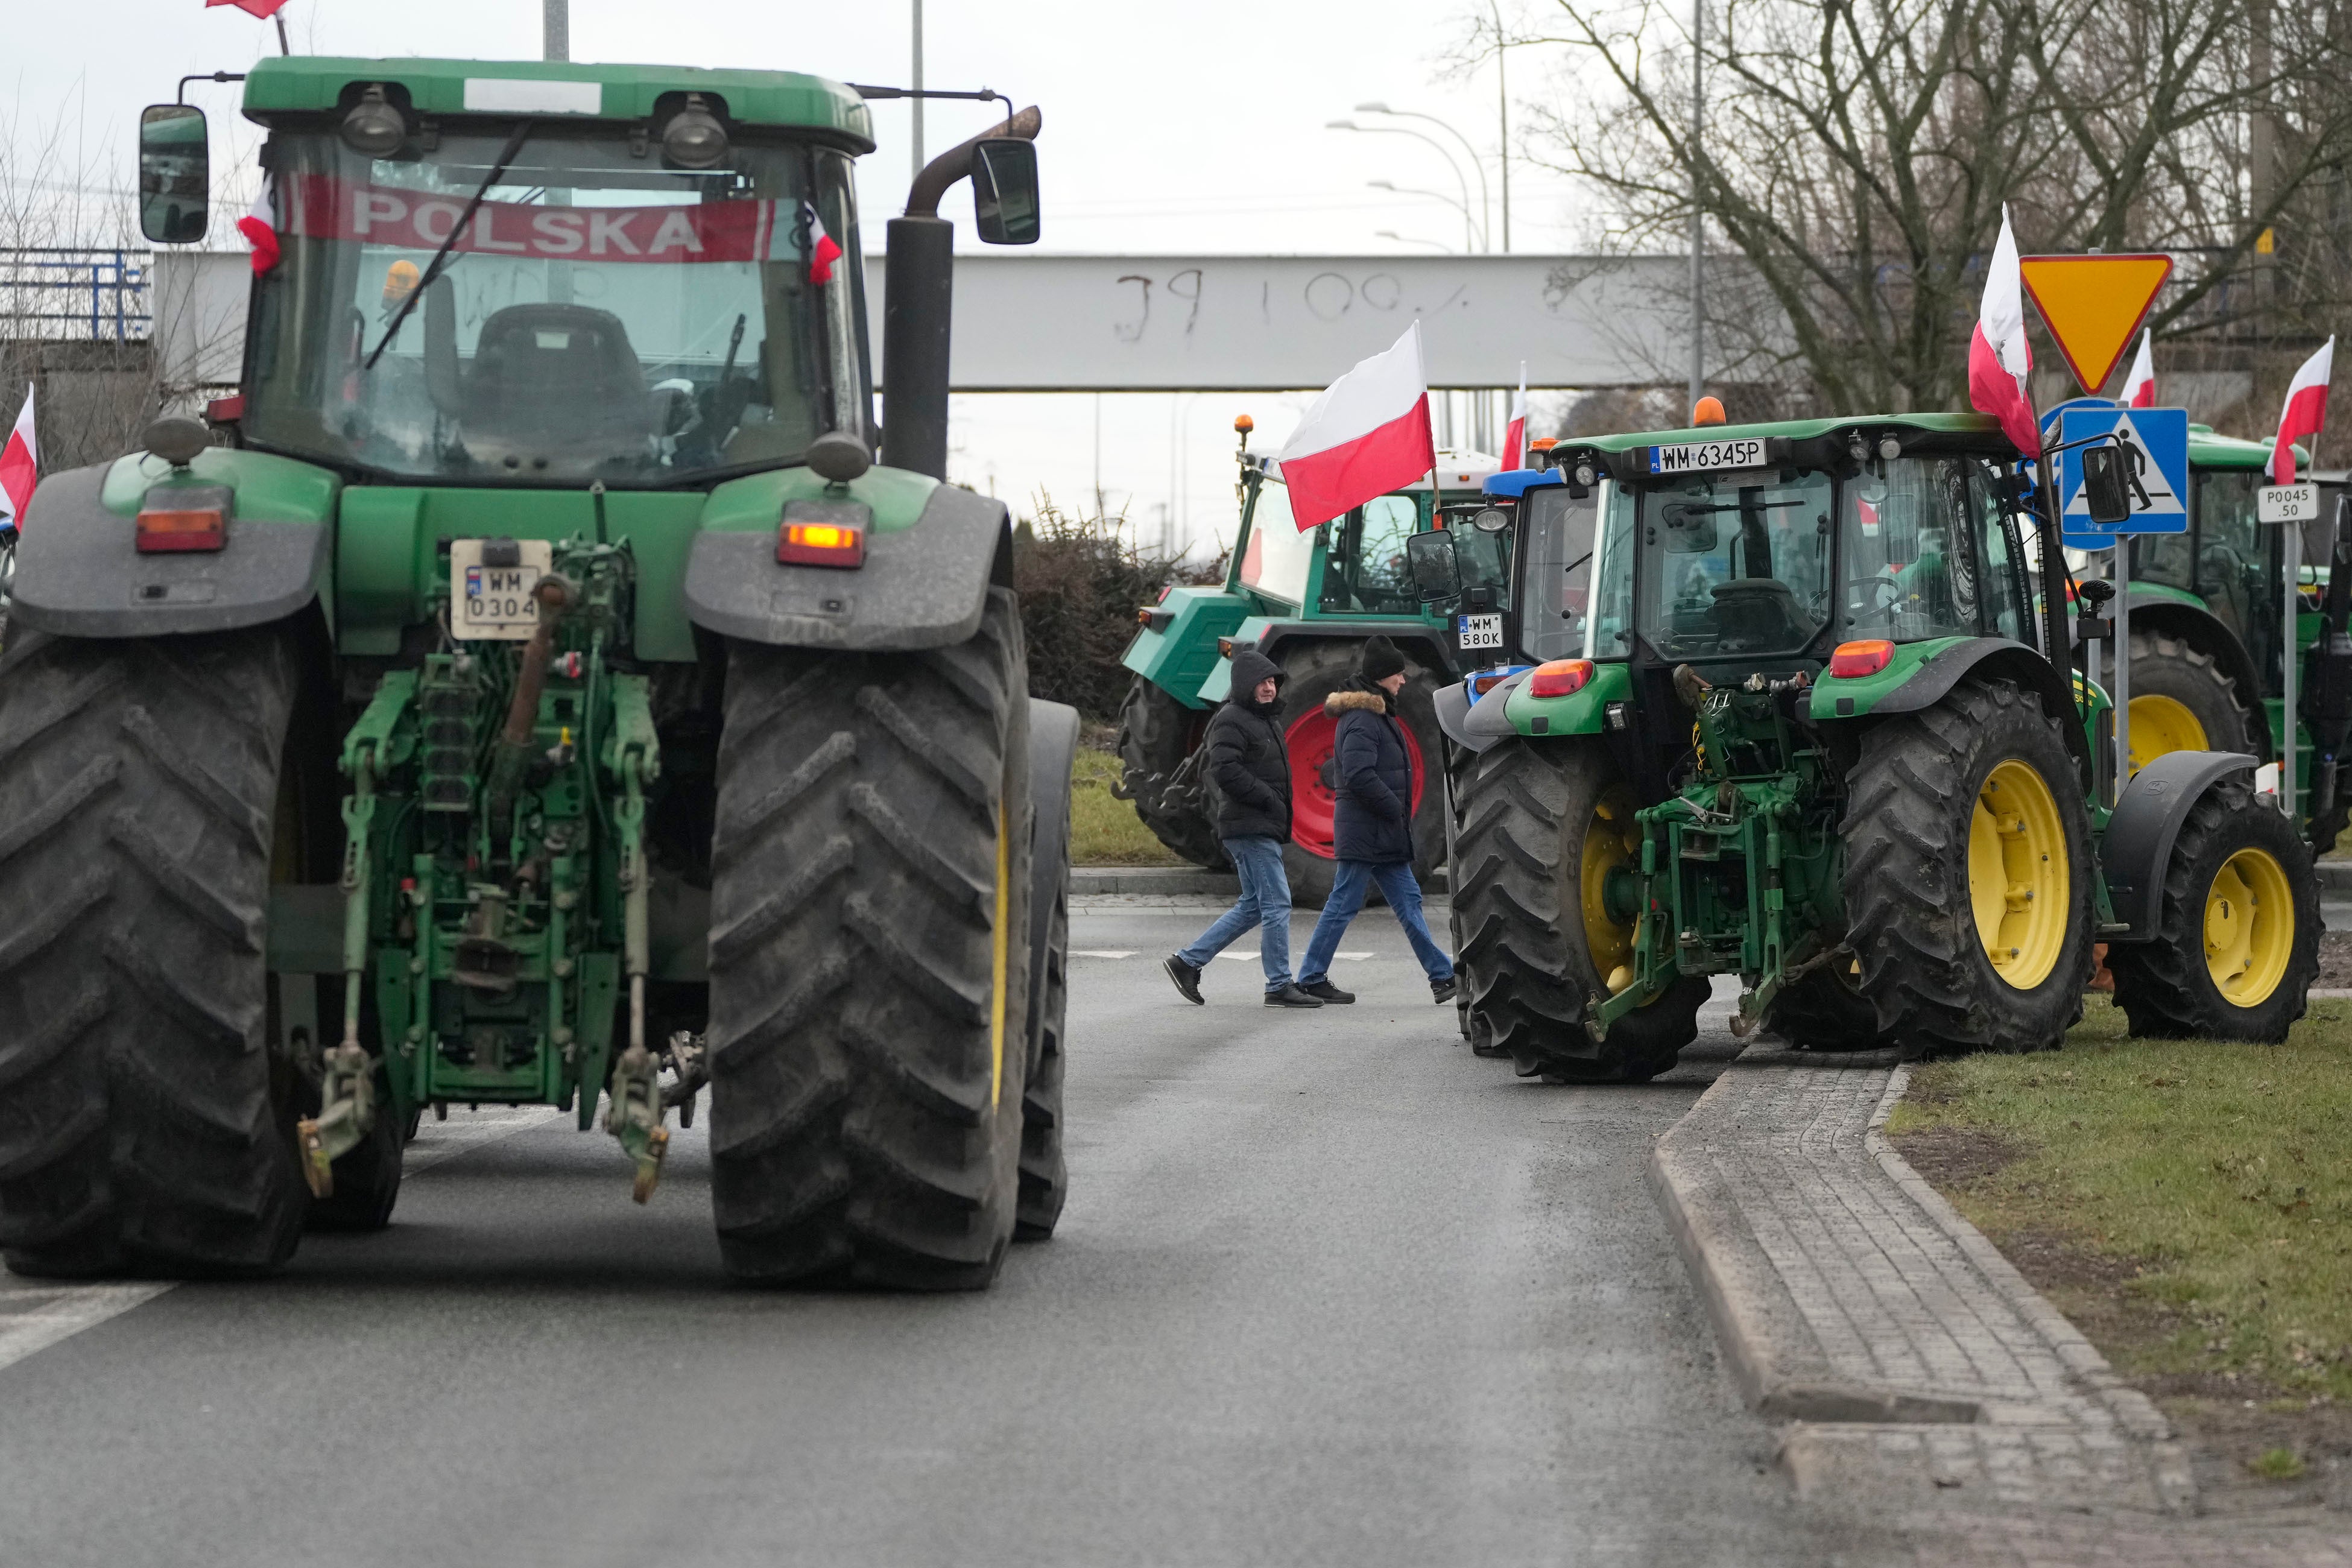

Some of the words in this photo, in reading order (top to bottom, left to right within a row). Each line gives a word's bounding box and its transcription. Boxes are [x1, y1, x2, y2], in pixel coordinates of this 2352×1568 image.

[352, 191, 704, 256] POLSKA
[1663, 447, 1690, 470] WM
[1698, 441, 1759, 467] 6345P
[2267, 489, 2309, 503] P0045
[2278, 504, 2298, 517] .50
[490, 573, 520, 591] WM
[1472, 618, 1491, 630] WM
[1463, 633, 1499, 645] 580K
